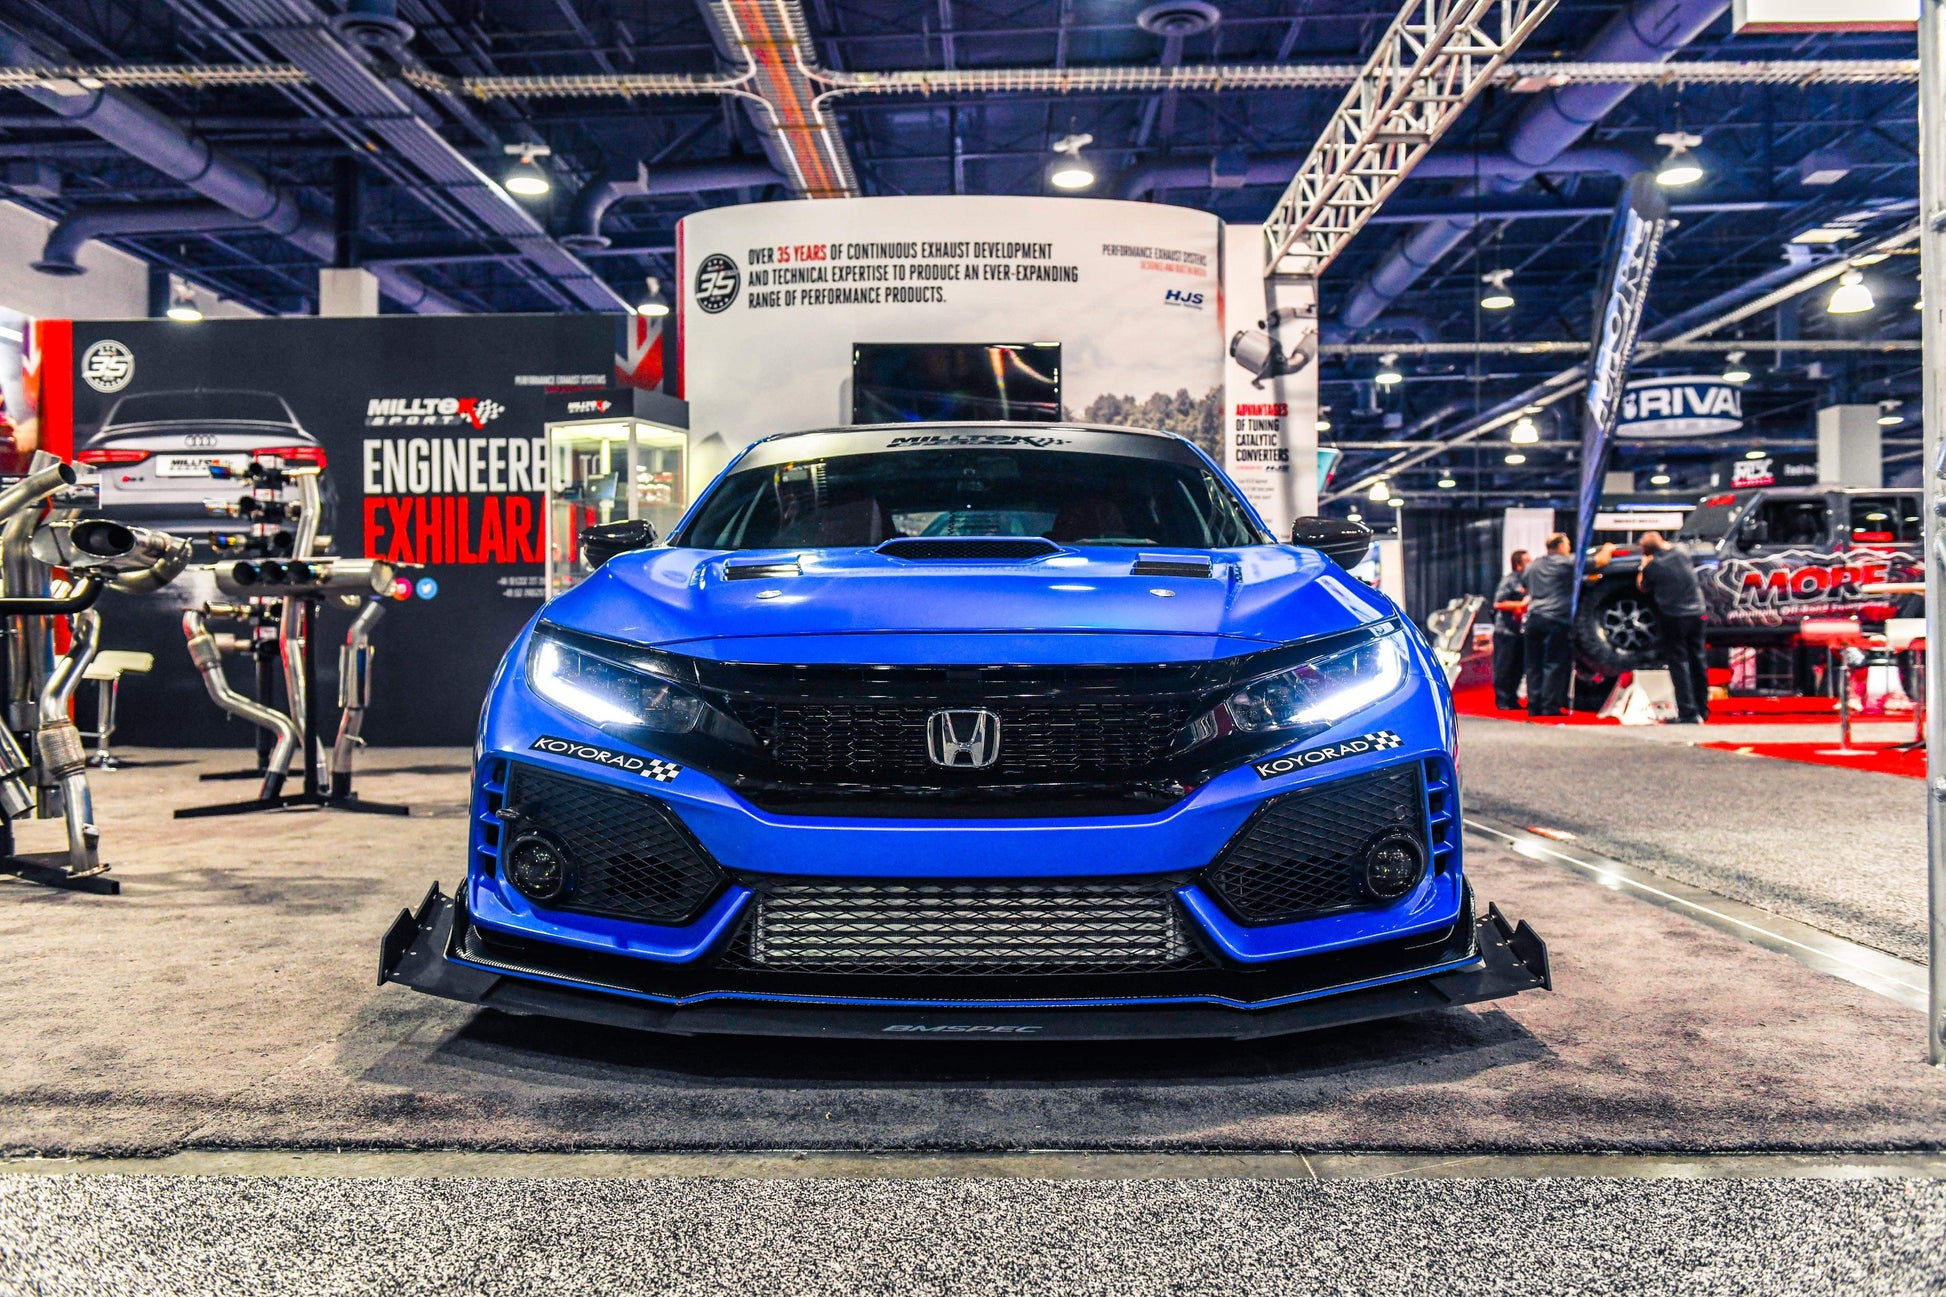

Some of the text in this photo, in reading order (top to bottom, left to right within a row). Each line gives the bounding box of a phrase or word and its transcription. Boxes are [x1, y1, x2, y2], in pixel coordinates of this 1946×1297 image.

[748, 242, 1053, 265] OVER 35 YEARS OF CONTINUOUS EXHAUST DEVELOPMENT
[1102, 243, 1153, 259] PERFORMANCE
[1154, 247, 1182, 262] EXHAUST
[696, 270, 736, 299] 35
[748, 264, 1079, 287] AND TECHNICAL EXPERTISE TO PRODUCE AN EVER-EXPANDING
[748, 286, 947, 309] RANGE OF PERFORMANCE PRODUCTS.
[1165, 289, 1204, 305] HJS
[1236, 403, 1288, 416] ADVANTAGES
[371, 416, 455, 426] SPORT
[1236, 418, 1280, 431] OF TUNING
[1236, 434, 1277, 446] CATALYTIC
[1236, 448, 1289, 462] CONVERTERS
[534, 738, 644, 769] KOYORAD
[1257, 740, 1370, 777] KOYORAD
